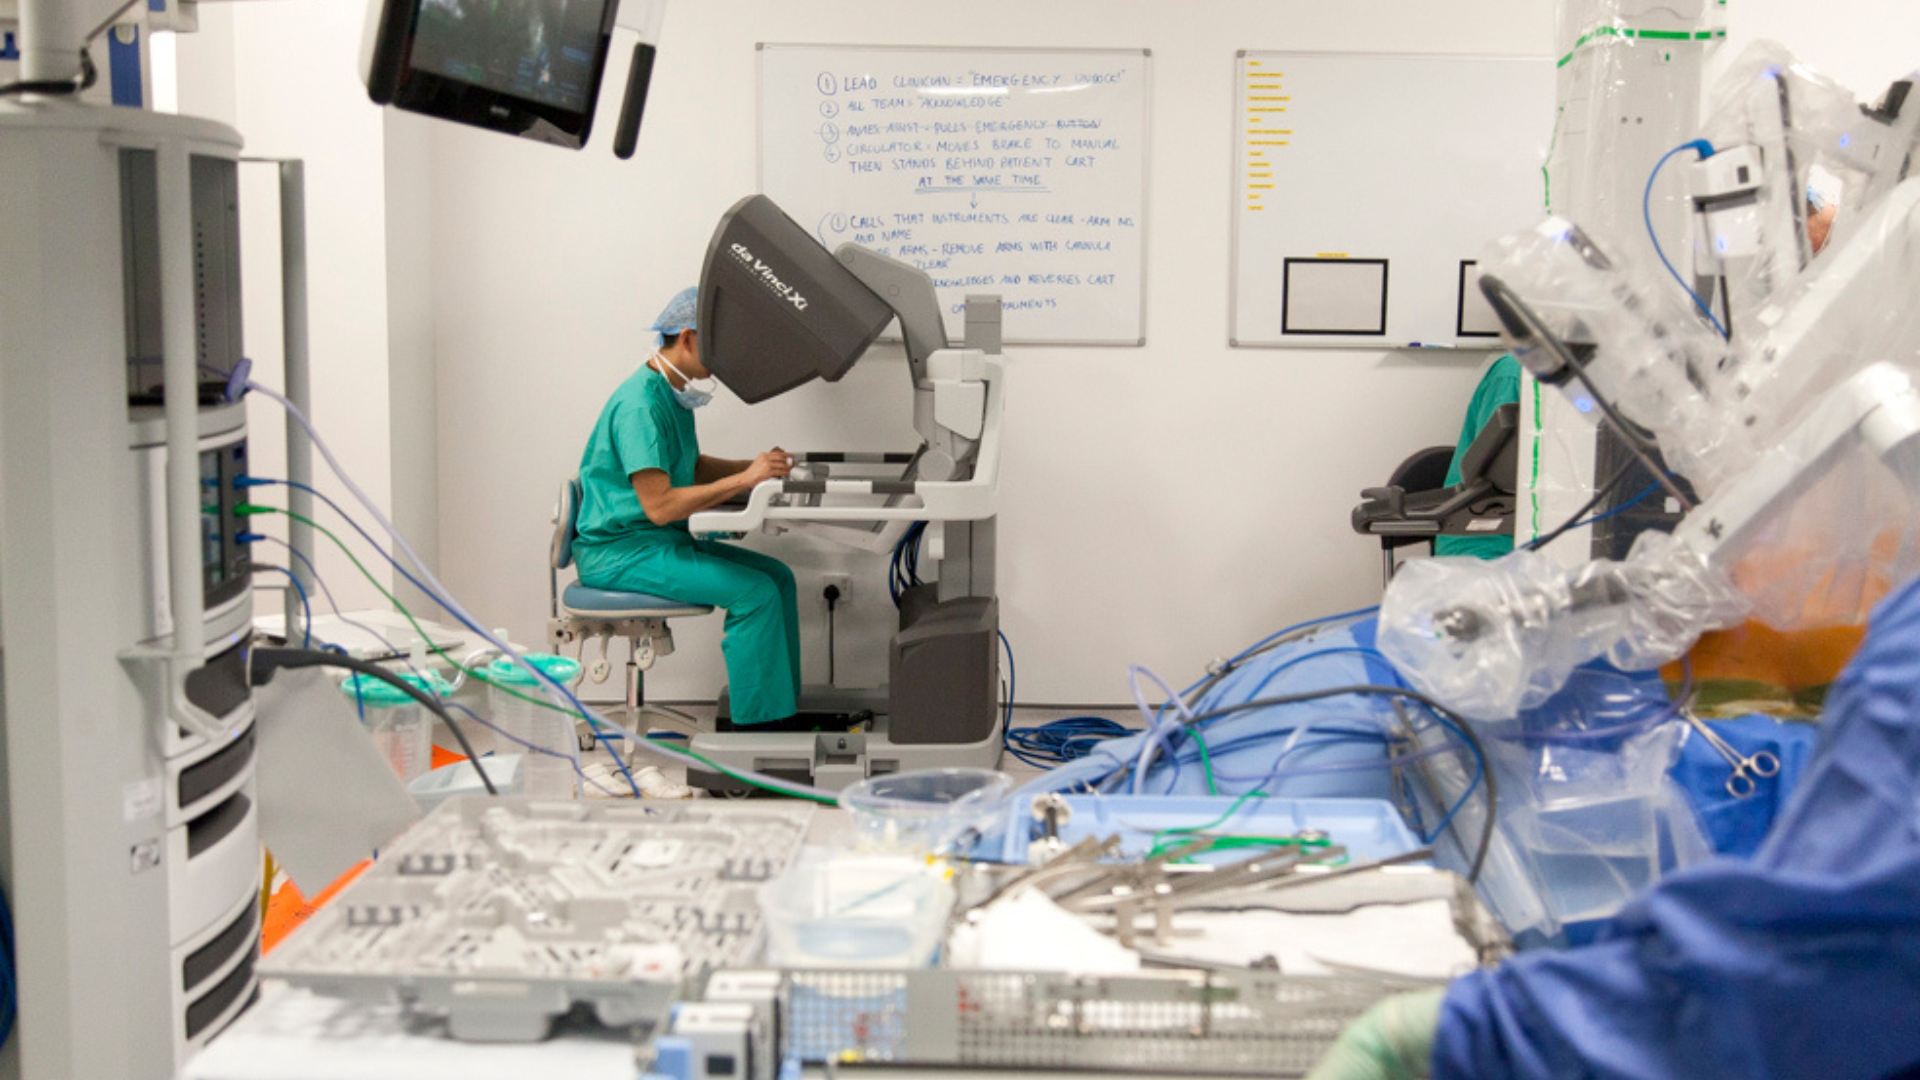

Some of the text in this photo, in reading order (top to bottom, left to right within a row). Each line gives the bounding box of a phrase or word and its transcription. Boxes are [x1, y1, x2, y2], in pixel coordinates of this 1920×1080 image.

[844, 76, 877, 92] LEAD
[893, 75, 951, 88] CLINICIAN
[847, 100, 865, 112] ALL
[934, 122, 966, 135] PULLS
[975, 120, 1048, 135] EMERGENCY
[846, 141, 922, 157] CIRCULATOR
[936, 140, 980, 153] MOVES
[992, 138, 1032, 151] BRAKE
[1045, 137, 1062, 150] TO
[1071, 137, 1120, 150] MANUAL
[849, 155, 1095, 174] THEN STANDS BEHIND PATIENT CART
[918, 173, 1041, 188] AT THE SAME TIME
[850, 214, 884, 229] CALLS
[893, 212, 924, 225] THAT
[931, 212, 1009, 225] INSTRUMENTS
[1018, 213, 1039, 224] ARE
[1045, 213, 1074, 225] CLEAR
[854, 228, 912, 244] AND NAME
[899, 243, 929, 257] ARMS
[942, 242, 984, 256] REMOVE
[994, 240, 1023, 253] ARMS
[1030, 240, 1058, 252] WITH
[1001, 274, 1021, 285] AND
[1028, 273, 1081, 286] REVERSES
[1087, 273, 1116, 286] CART
